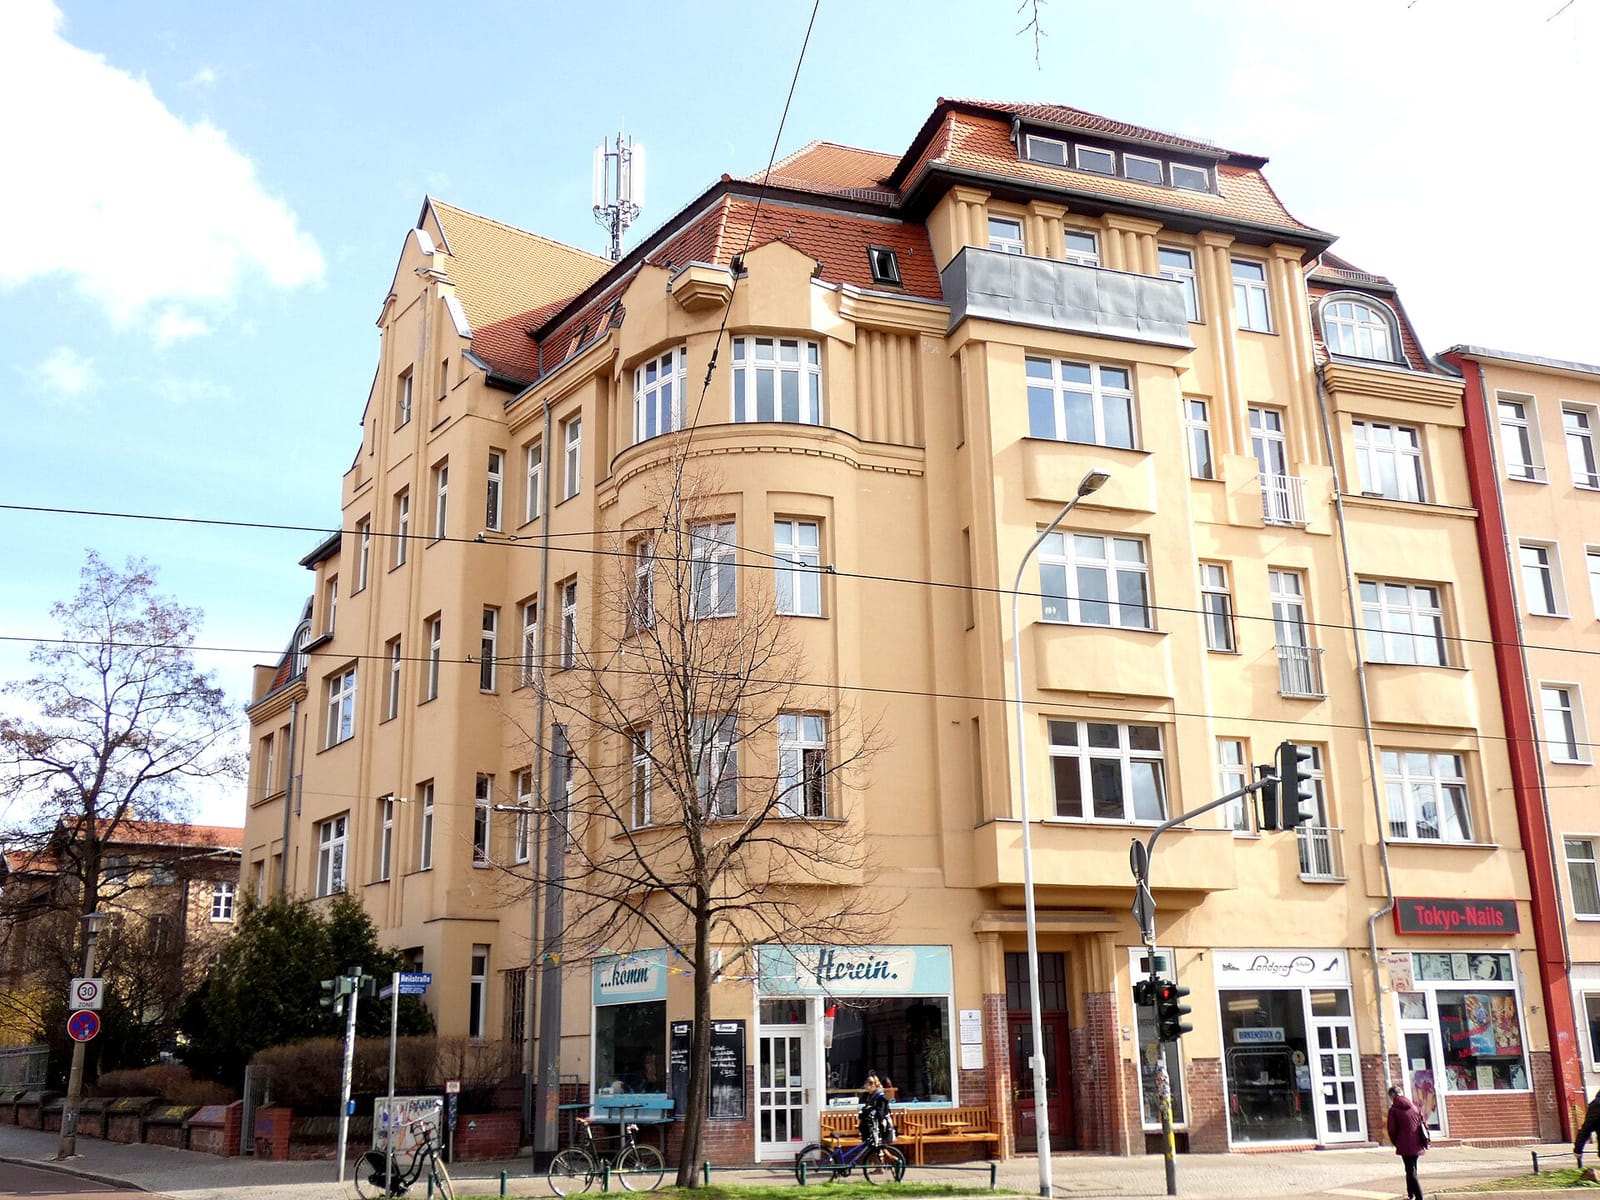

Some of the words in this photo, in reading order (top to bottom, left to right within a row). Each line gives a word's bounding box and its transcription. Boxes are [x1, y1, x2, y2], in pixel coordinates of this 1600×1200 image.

[1414, 904, 1504, 931] Tokyo-Nails
[816, 948, 899, 986] Herein.
[1246, 954, 1315, 977] Landgraf
[81, 986, 94, 997] 30
[1239, 1030, 1274, 1040] BIRKENSTOCK
